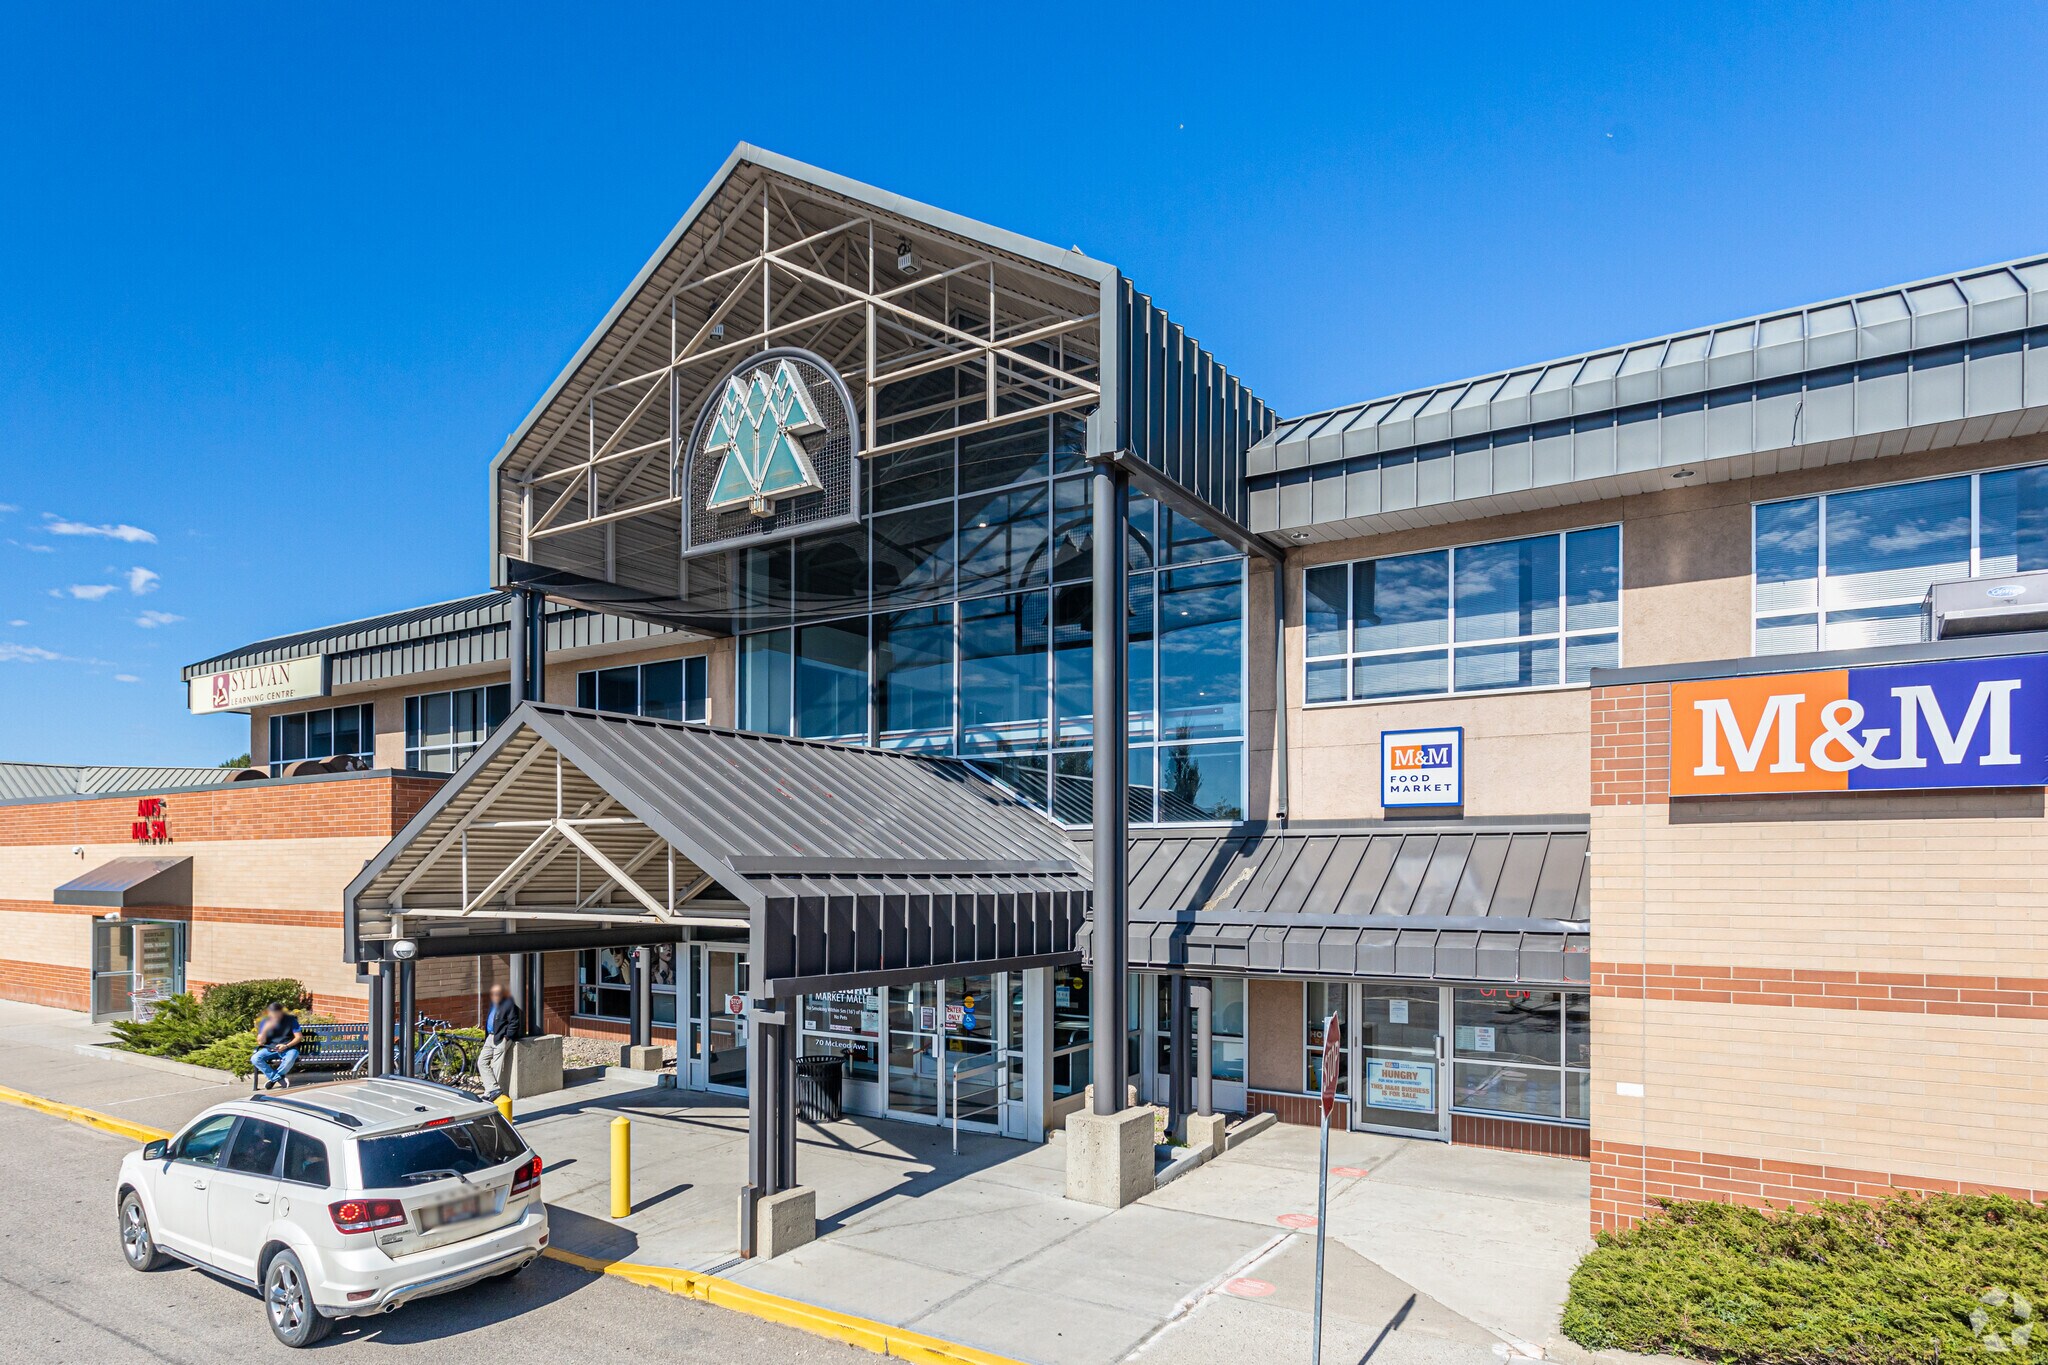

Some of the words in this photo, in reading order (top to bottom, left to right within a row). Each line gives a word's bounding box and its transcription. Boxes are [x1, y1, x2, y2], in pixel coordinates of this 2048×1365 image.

[232, 664, 290, 692] SYLVAN
[231, 693, 264, 706] LEARNING
[267, 689, 295, 700] CENTRE
[1693, 679, 2022, 777] M&M
[1394, 747, 1449, 767] M&M
[1391, 775, 1430, 783] FOOD
[1391, 783, 1452, 793] MARKET
[815, 992, 845, 1003] MARKET
[847, 994, 866, 1004] MALL
[946, 1006, 962, 1014] ENTER
[825, 1040, 852, 1048] McLeod
[852, 1043, 868, 1051] Ave.
[1323, 1040, 1340, 1092] STOP
[1382, 1069, 1418, 1080] HUNGRY
[1402, 1086, 1430, 1095] BUSINESS
